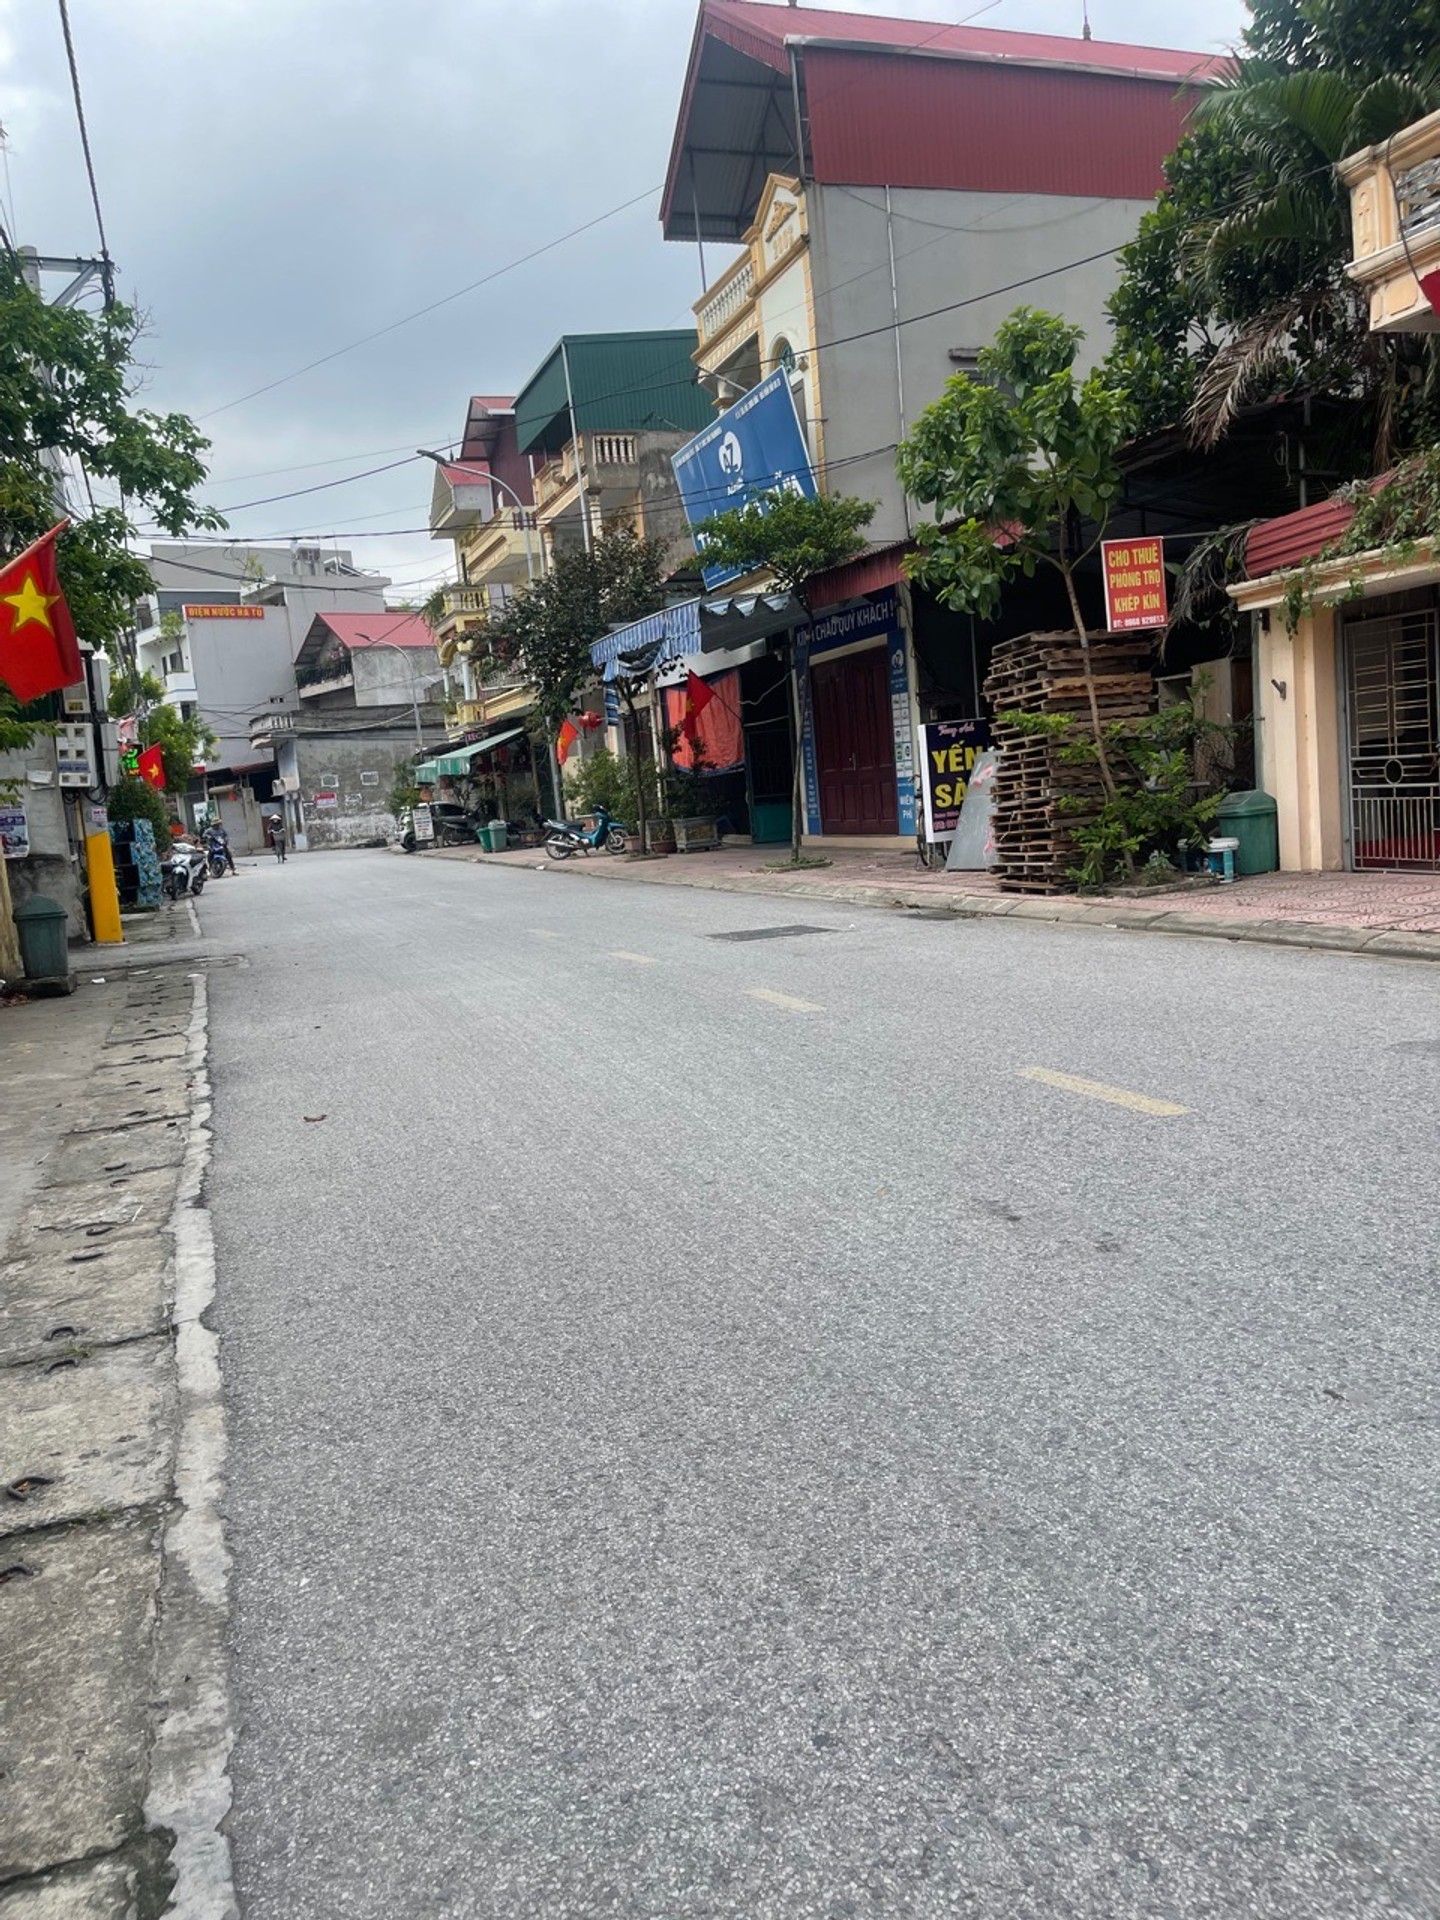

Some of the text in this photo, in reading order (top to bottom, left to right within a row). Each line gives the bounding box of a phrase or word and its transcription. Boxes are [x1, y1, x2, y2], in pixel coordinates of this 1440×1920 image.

[1108, 542, 1159, 568] CHO THUÊ
[1109, 569, 1161, 589] PHÒNG TRỌ
[1114, 592, 1161, 613] KHÉP KÍN
[931, 740, 984, 774] YẾN
[935, 777, 968, 808] SÀ
